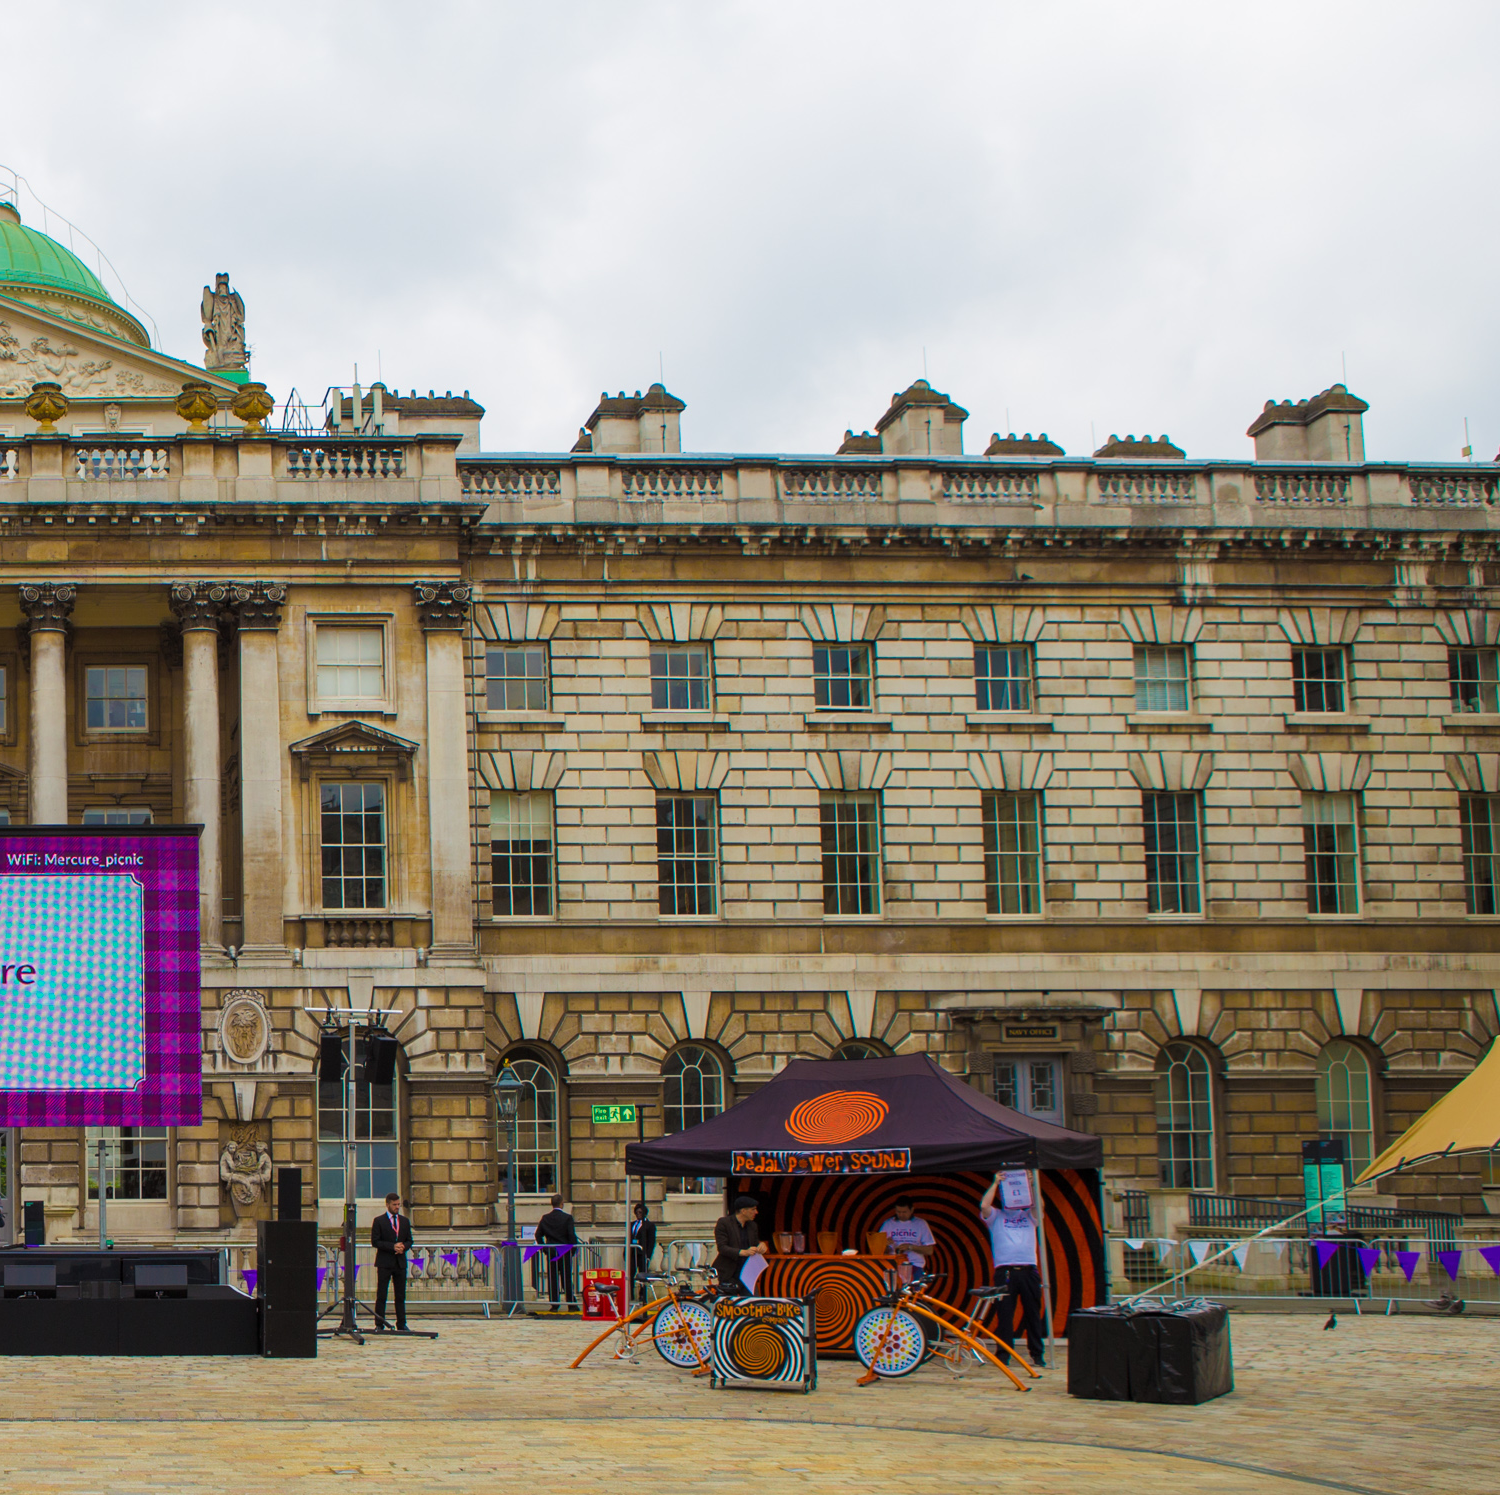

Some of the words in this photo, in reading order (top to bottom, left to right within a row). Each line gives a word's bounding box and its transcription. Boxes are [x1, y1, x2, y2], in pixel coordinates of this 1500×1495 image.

[7, 853, 42, 866] WiFi:
[44, 853, 144, 868] Mercure_picnic
[891, 1229, 917, 1237] picnic
